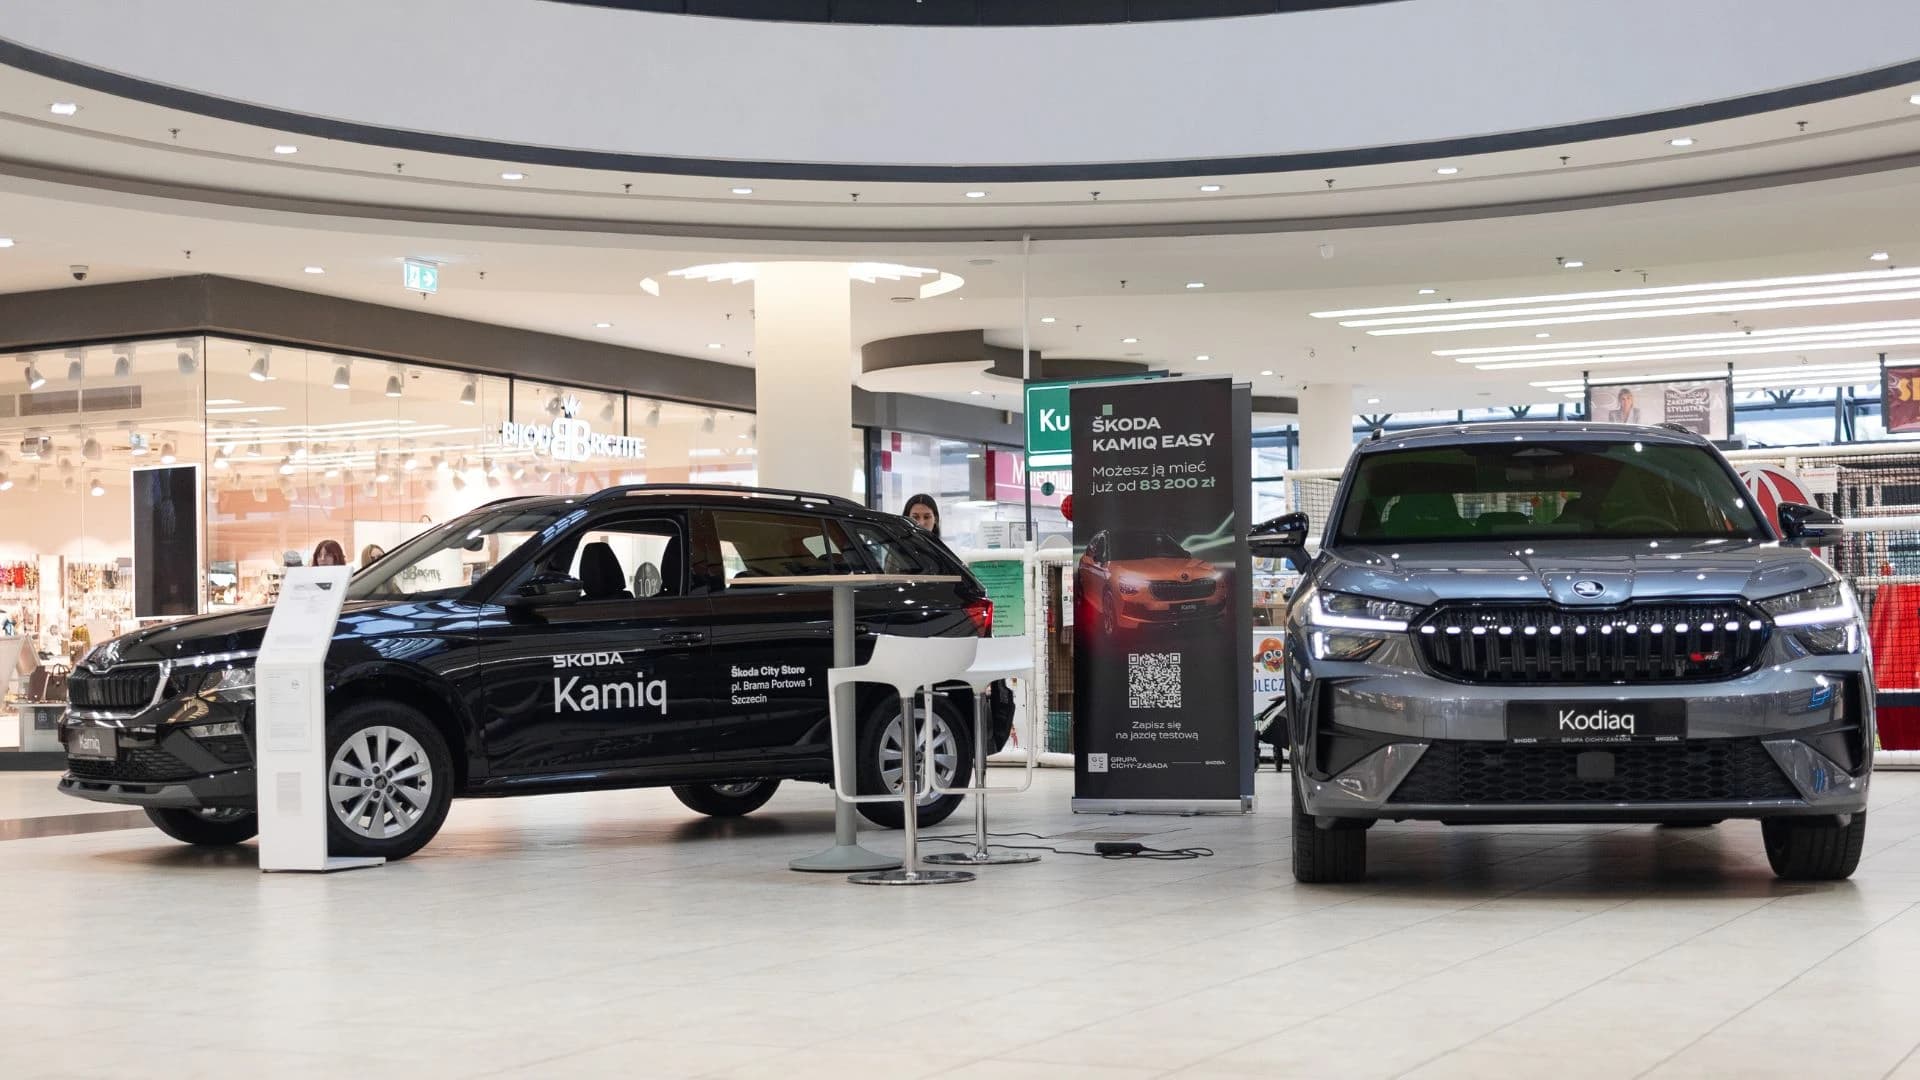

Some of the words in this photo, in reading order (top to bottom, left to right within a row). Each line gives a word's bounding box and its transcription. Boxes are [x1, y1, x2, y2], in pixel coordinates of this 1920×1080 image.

[1092, 416, 1161, 433] ŠKODA
[1093, 436, 1157, 452] KAMIQ
[1162, 432, 1215, 449] EASY
[1093, 465, 1148, 477] Możesz
[1151, 463, 1165, 477] ją
[1169, 460, 1207, 474] mieć
[1091, 481, 1113, 496] już
[1117, 480, 1136, 492] od
[1140, 479, 1161, 491] 83
[1164, 478, 1198, 489] 200
[1201, 476, 1216, 488] zł
[731, 665, 759, 677] Škoda
[760, 666, 780, 677] City
[781, 665, 805, 675] Store
[554, 671, 667, 715] Kamiq
[731, 681, 741, 693] pl.
[743, 681, 769, 691] Brama
[771, 679, 806, 689] Portowa
[807, 677, 813, 687] 1
[731, 694, 768, 705] Szczecin
[1132, 721, 1165, 730] Zapisz
[1167, 721, 1182, 730] się
[1559, 710, 1635, 734] Kodiaq
[1116, 731, 1128, 739] na
[1130, 731, 1157, 740] jazdę
[1159, 731, 1199, 740] testową
